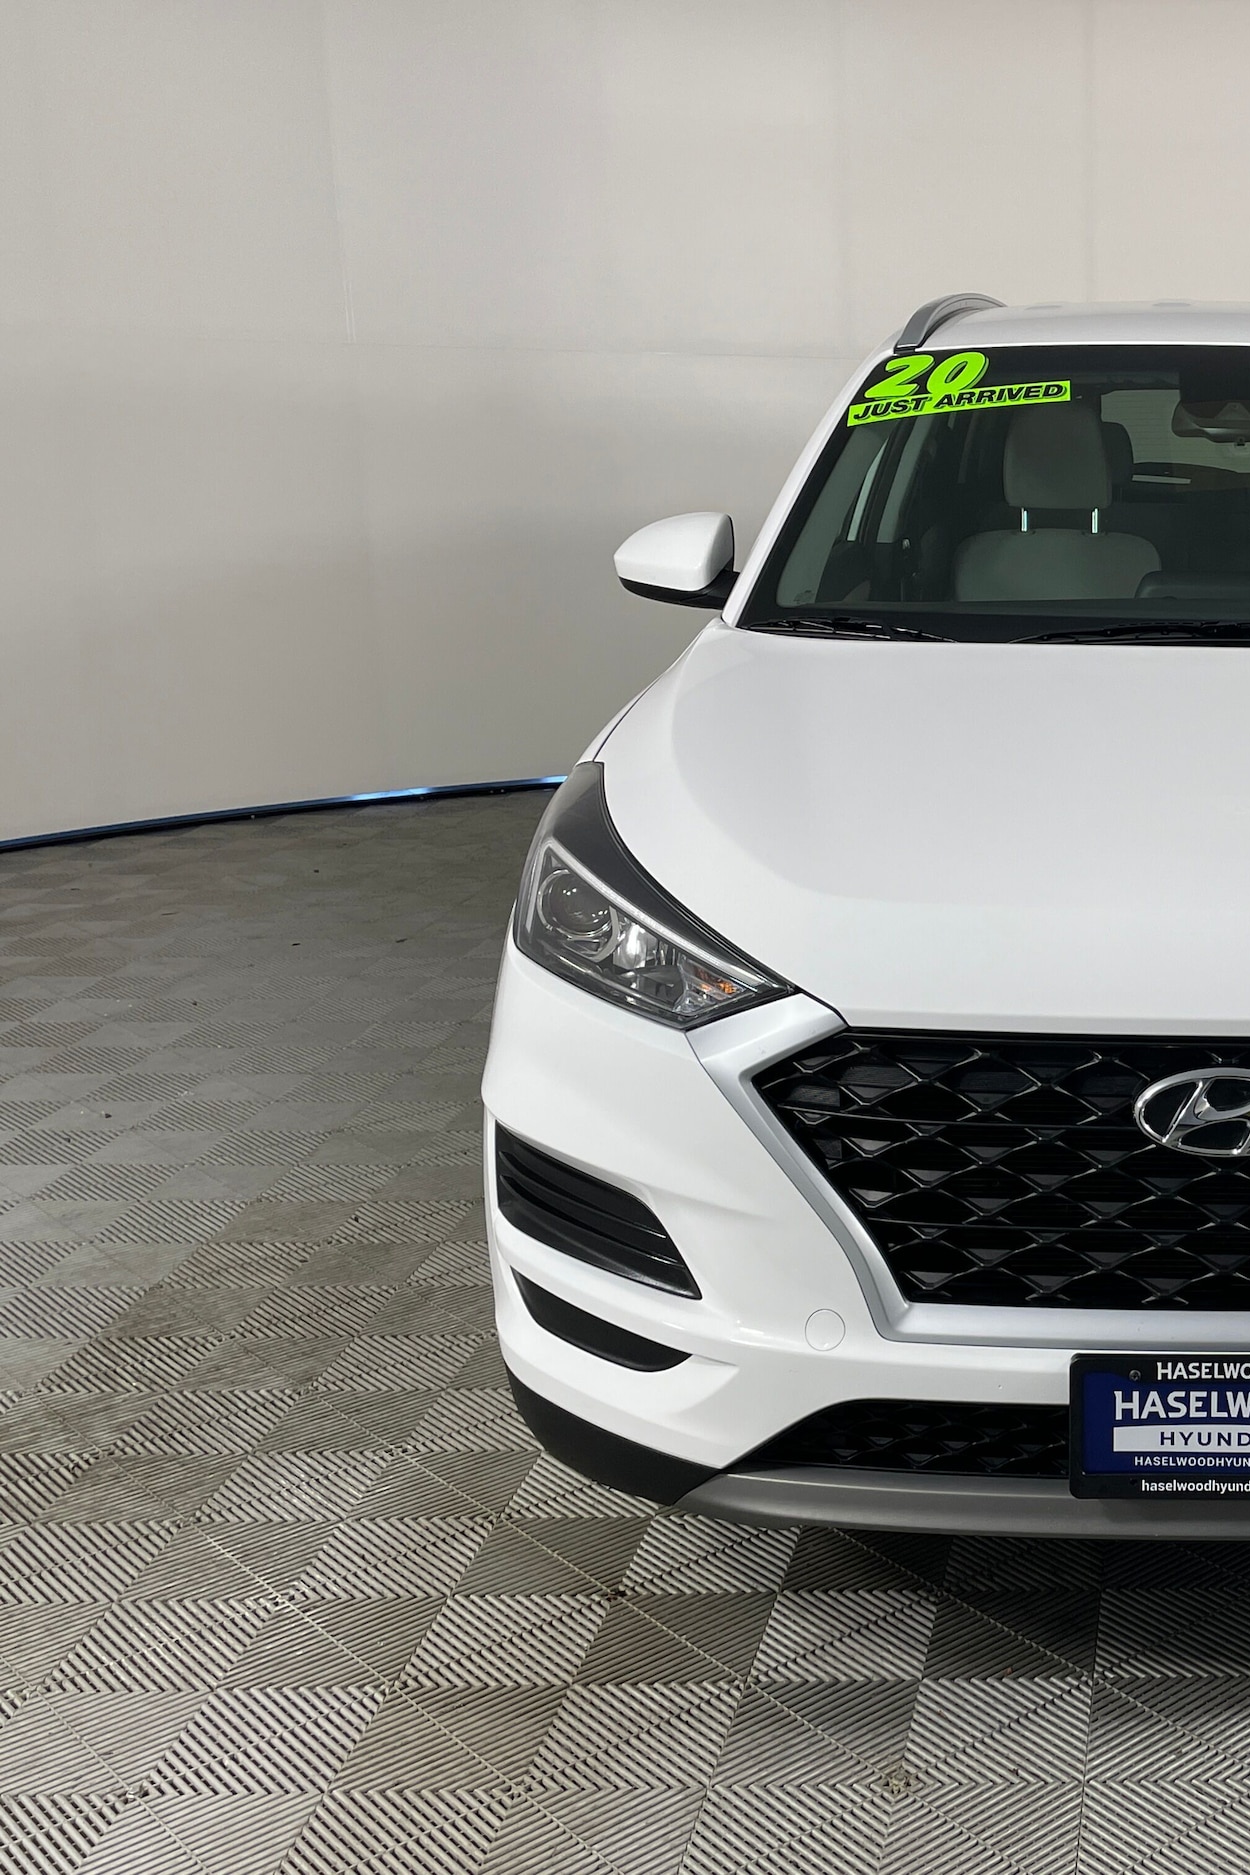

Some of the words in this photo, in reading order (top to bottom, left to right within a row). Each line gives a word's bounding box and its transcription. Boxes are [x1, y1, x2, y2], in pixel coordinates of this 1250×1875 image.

[864, 351, 989, 398] 20
[854, 396, 929, 420] JUST
[934, 383, 1067, 408] ARRIVED
